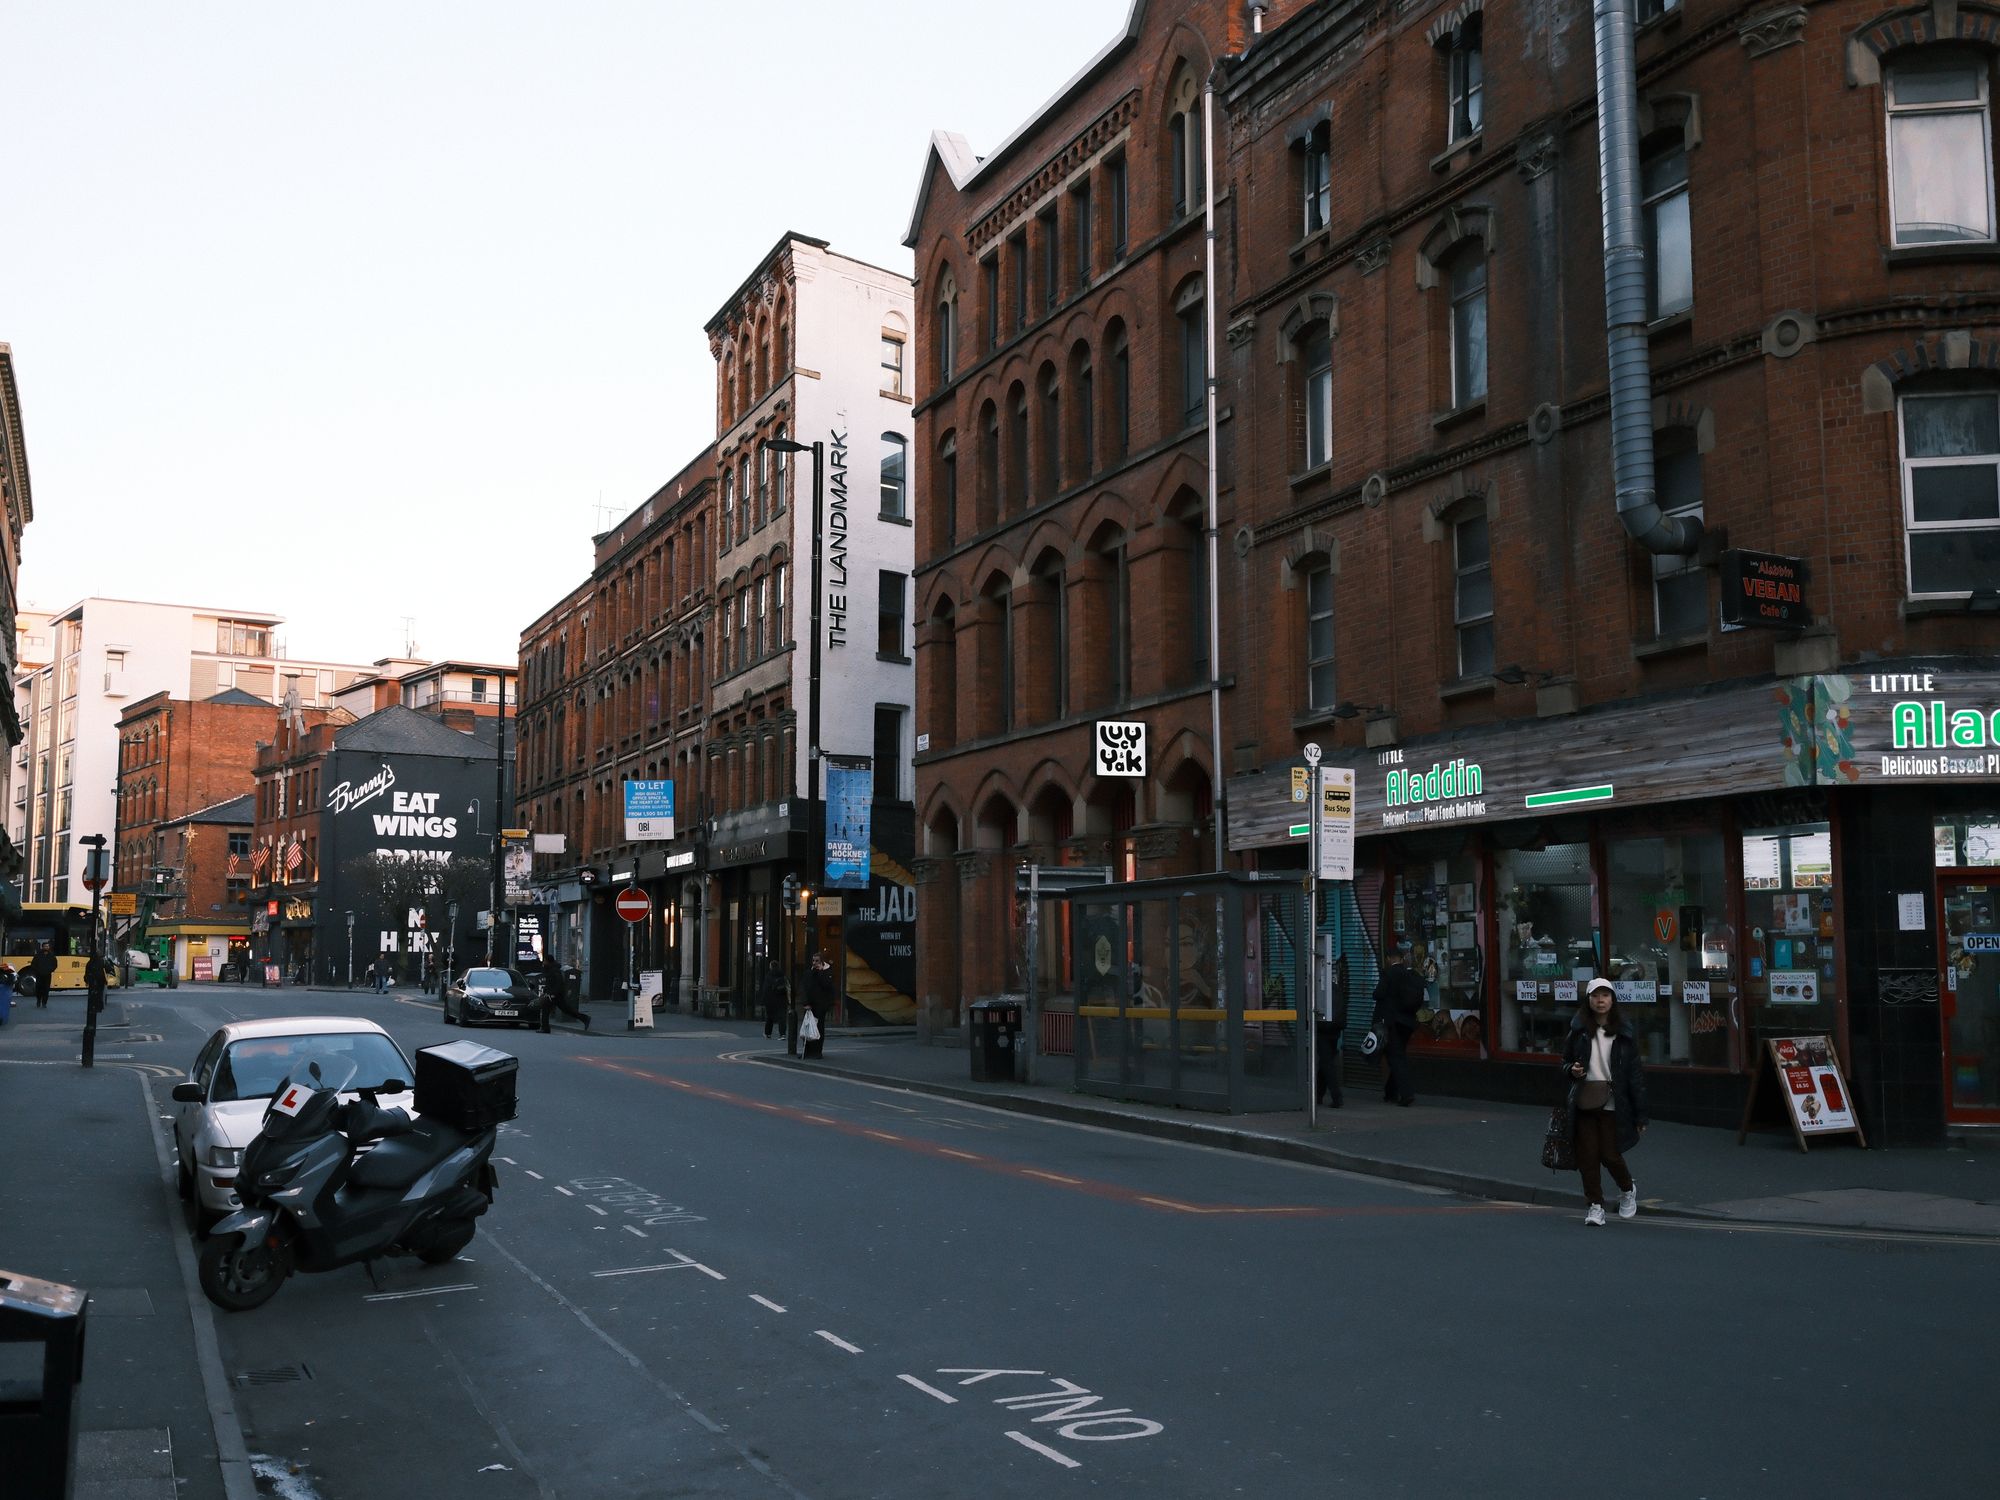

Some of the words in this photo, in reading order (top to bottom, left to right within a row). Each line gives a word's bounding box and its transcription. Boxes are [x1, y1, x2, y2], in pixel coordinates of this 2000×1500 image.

[829, 428, 848, 587] LANDMARK
[1743, 576, 1801, 603] VEGAN
[829, 594, 847, 650] THE
[1870, 674, 1935, 692] LITTLE
[1305, 747, 1320, 759] NZ
[1378, 749, 1404, 766] LITTLE
[1881, 756, 1938, 775] Delicious
[1940, 756, 1984, 774] Based
[633, 782, 646, 790] TO
[648, 781, 665, 790] LET
[1386, 758, 1482, 807] Aladdin
[326, 763, 397, 816] Bunny's
[1297, 791, 1302, 799] 2
[392, 791, 440, 814] EAT
[1324, 804, 1336, 812] Bus
[1336, 804, 1351, 814] Stop
[1382, 810, 1406, 827] Delicious
[1424, 806, 1439, 822] Plant
[1439, 803, 1455, 820] Foods
[1455, 802, 1467, 818] And
[1467, 800, 1486, 817] Drinks
[372, 814, 458, 839] WINGS
[827, 842, 853, 850] DAVID
[832, 849, 868, 858] HOCKNEY
[858, 907, 876, 921] THE
[879, 931, 895, 941] WORN
[894, 931, 902, 941] BY
[1967, 936, 2000, 949] OPEN
[889, 944, 912, 957] LYNKS
[1554, 981, 1577, 989] SAMOSA
[1948, 968, 1956, 989] PUSH
[1614, 982, 1625, 990] VEG
[1634, 981, 1655, 990] FALAFEL
[1683, 981, 1706, 990] ONION
[1558, 991, 1573, 999] CHAT
[1686, 993, 1704, 1001] BHAJI
[281, 1089, 297, 1109] L
[936, 1368, 1165, 1441] ONLY
